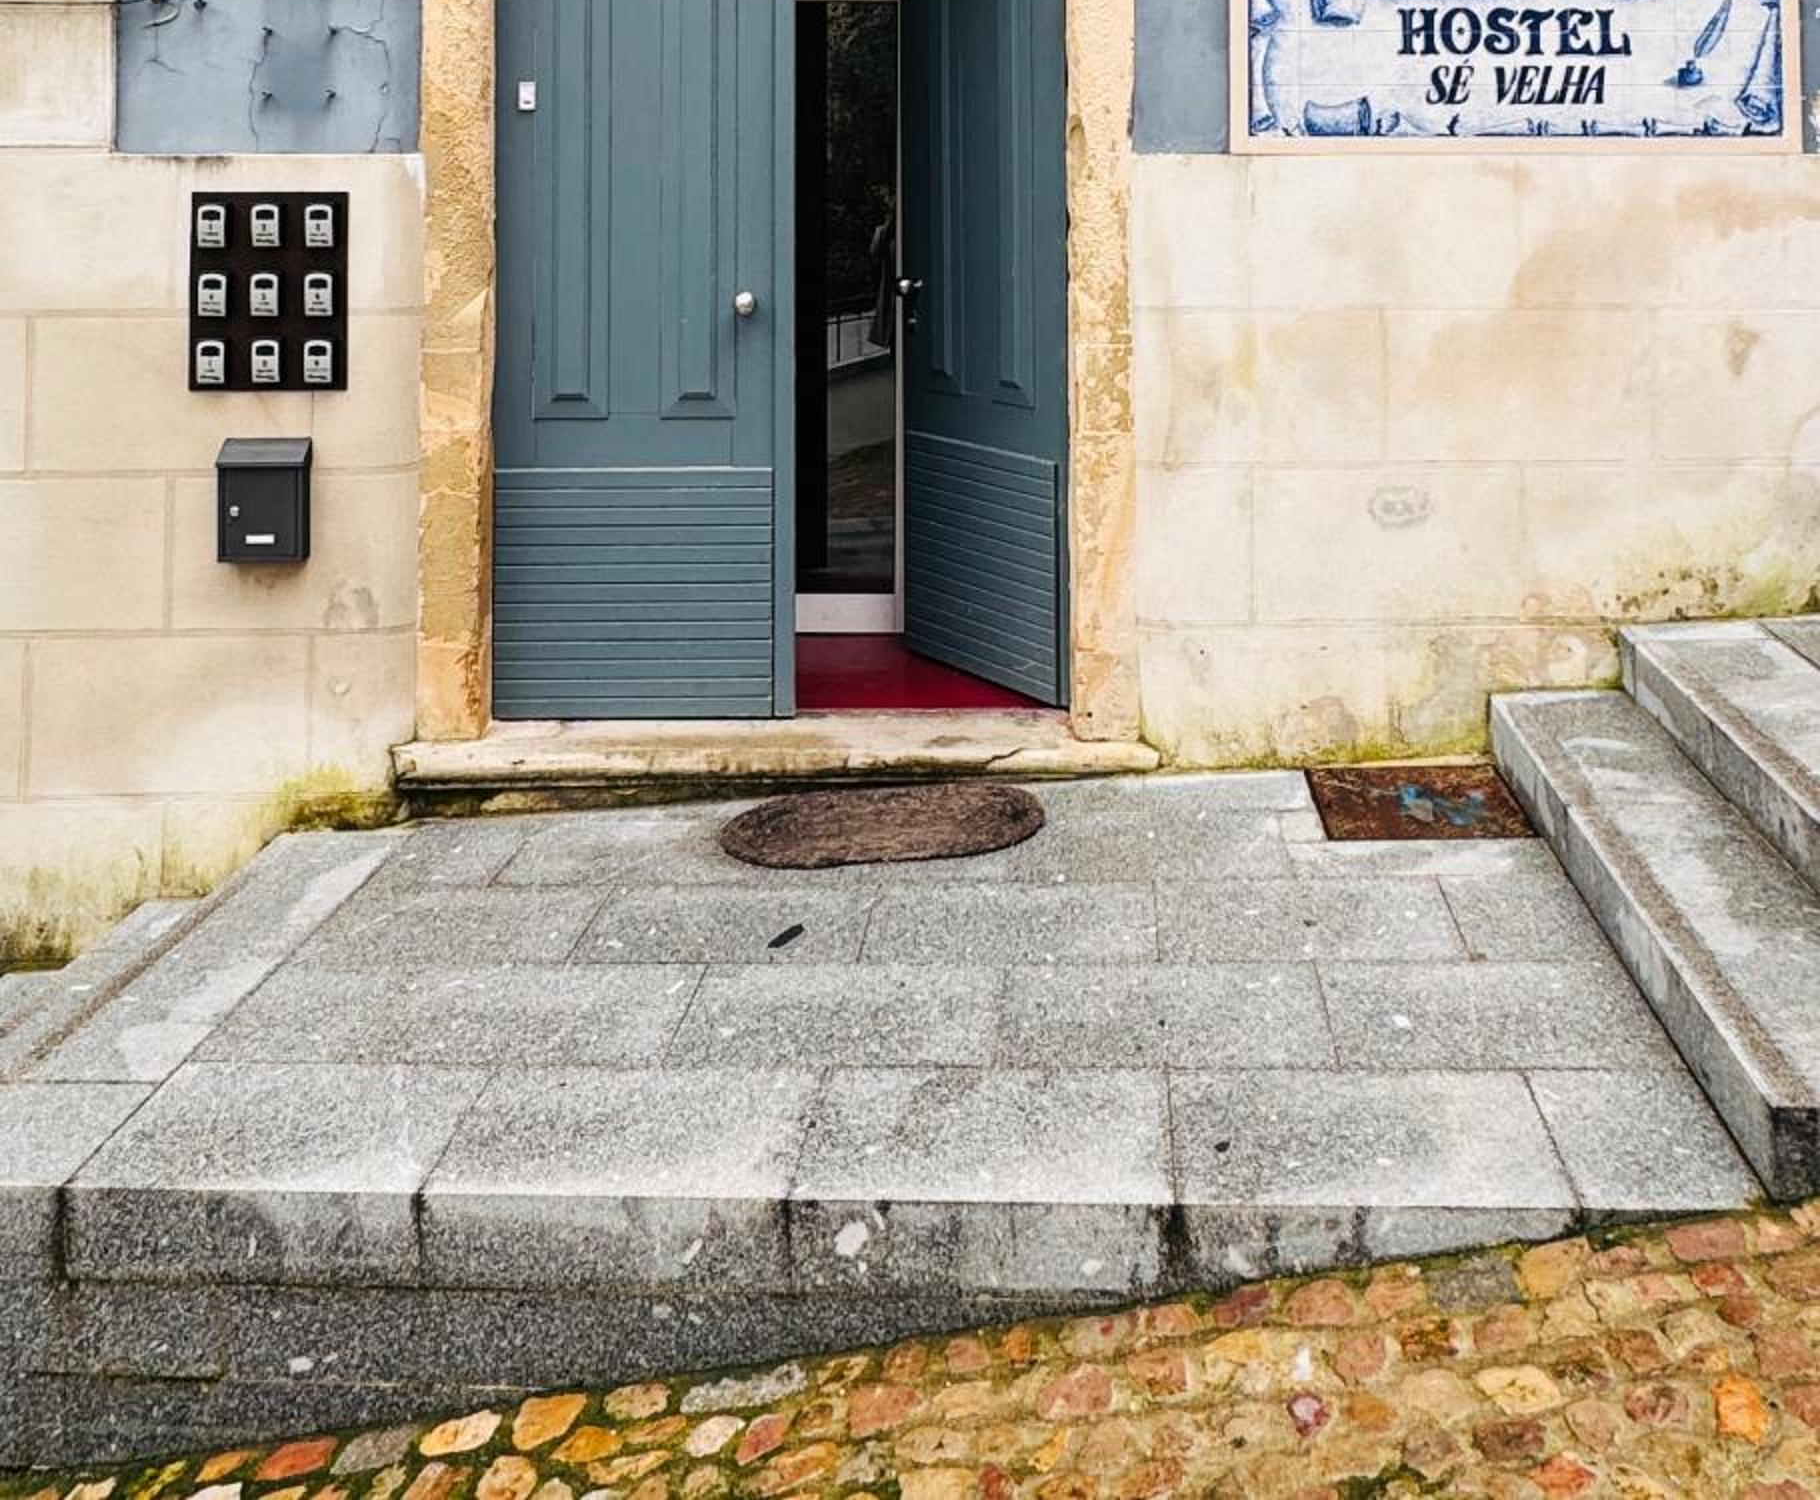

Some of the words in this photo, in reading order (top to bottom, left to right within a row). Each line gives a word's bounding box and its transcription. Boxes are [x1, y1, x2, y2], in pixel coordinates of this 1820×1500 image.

[1397, 7, 1632, 56] HOSTEL
[1426, 59, 1475, 105] SÉ
[1494, 65, 1606, 105] VELHA
